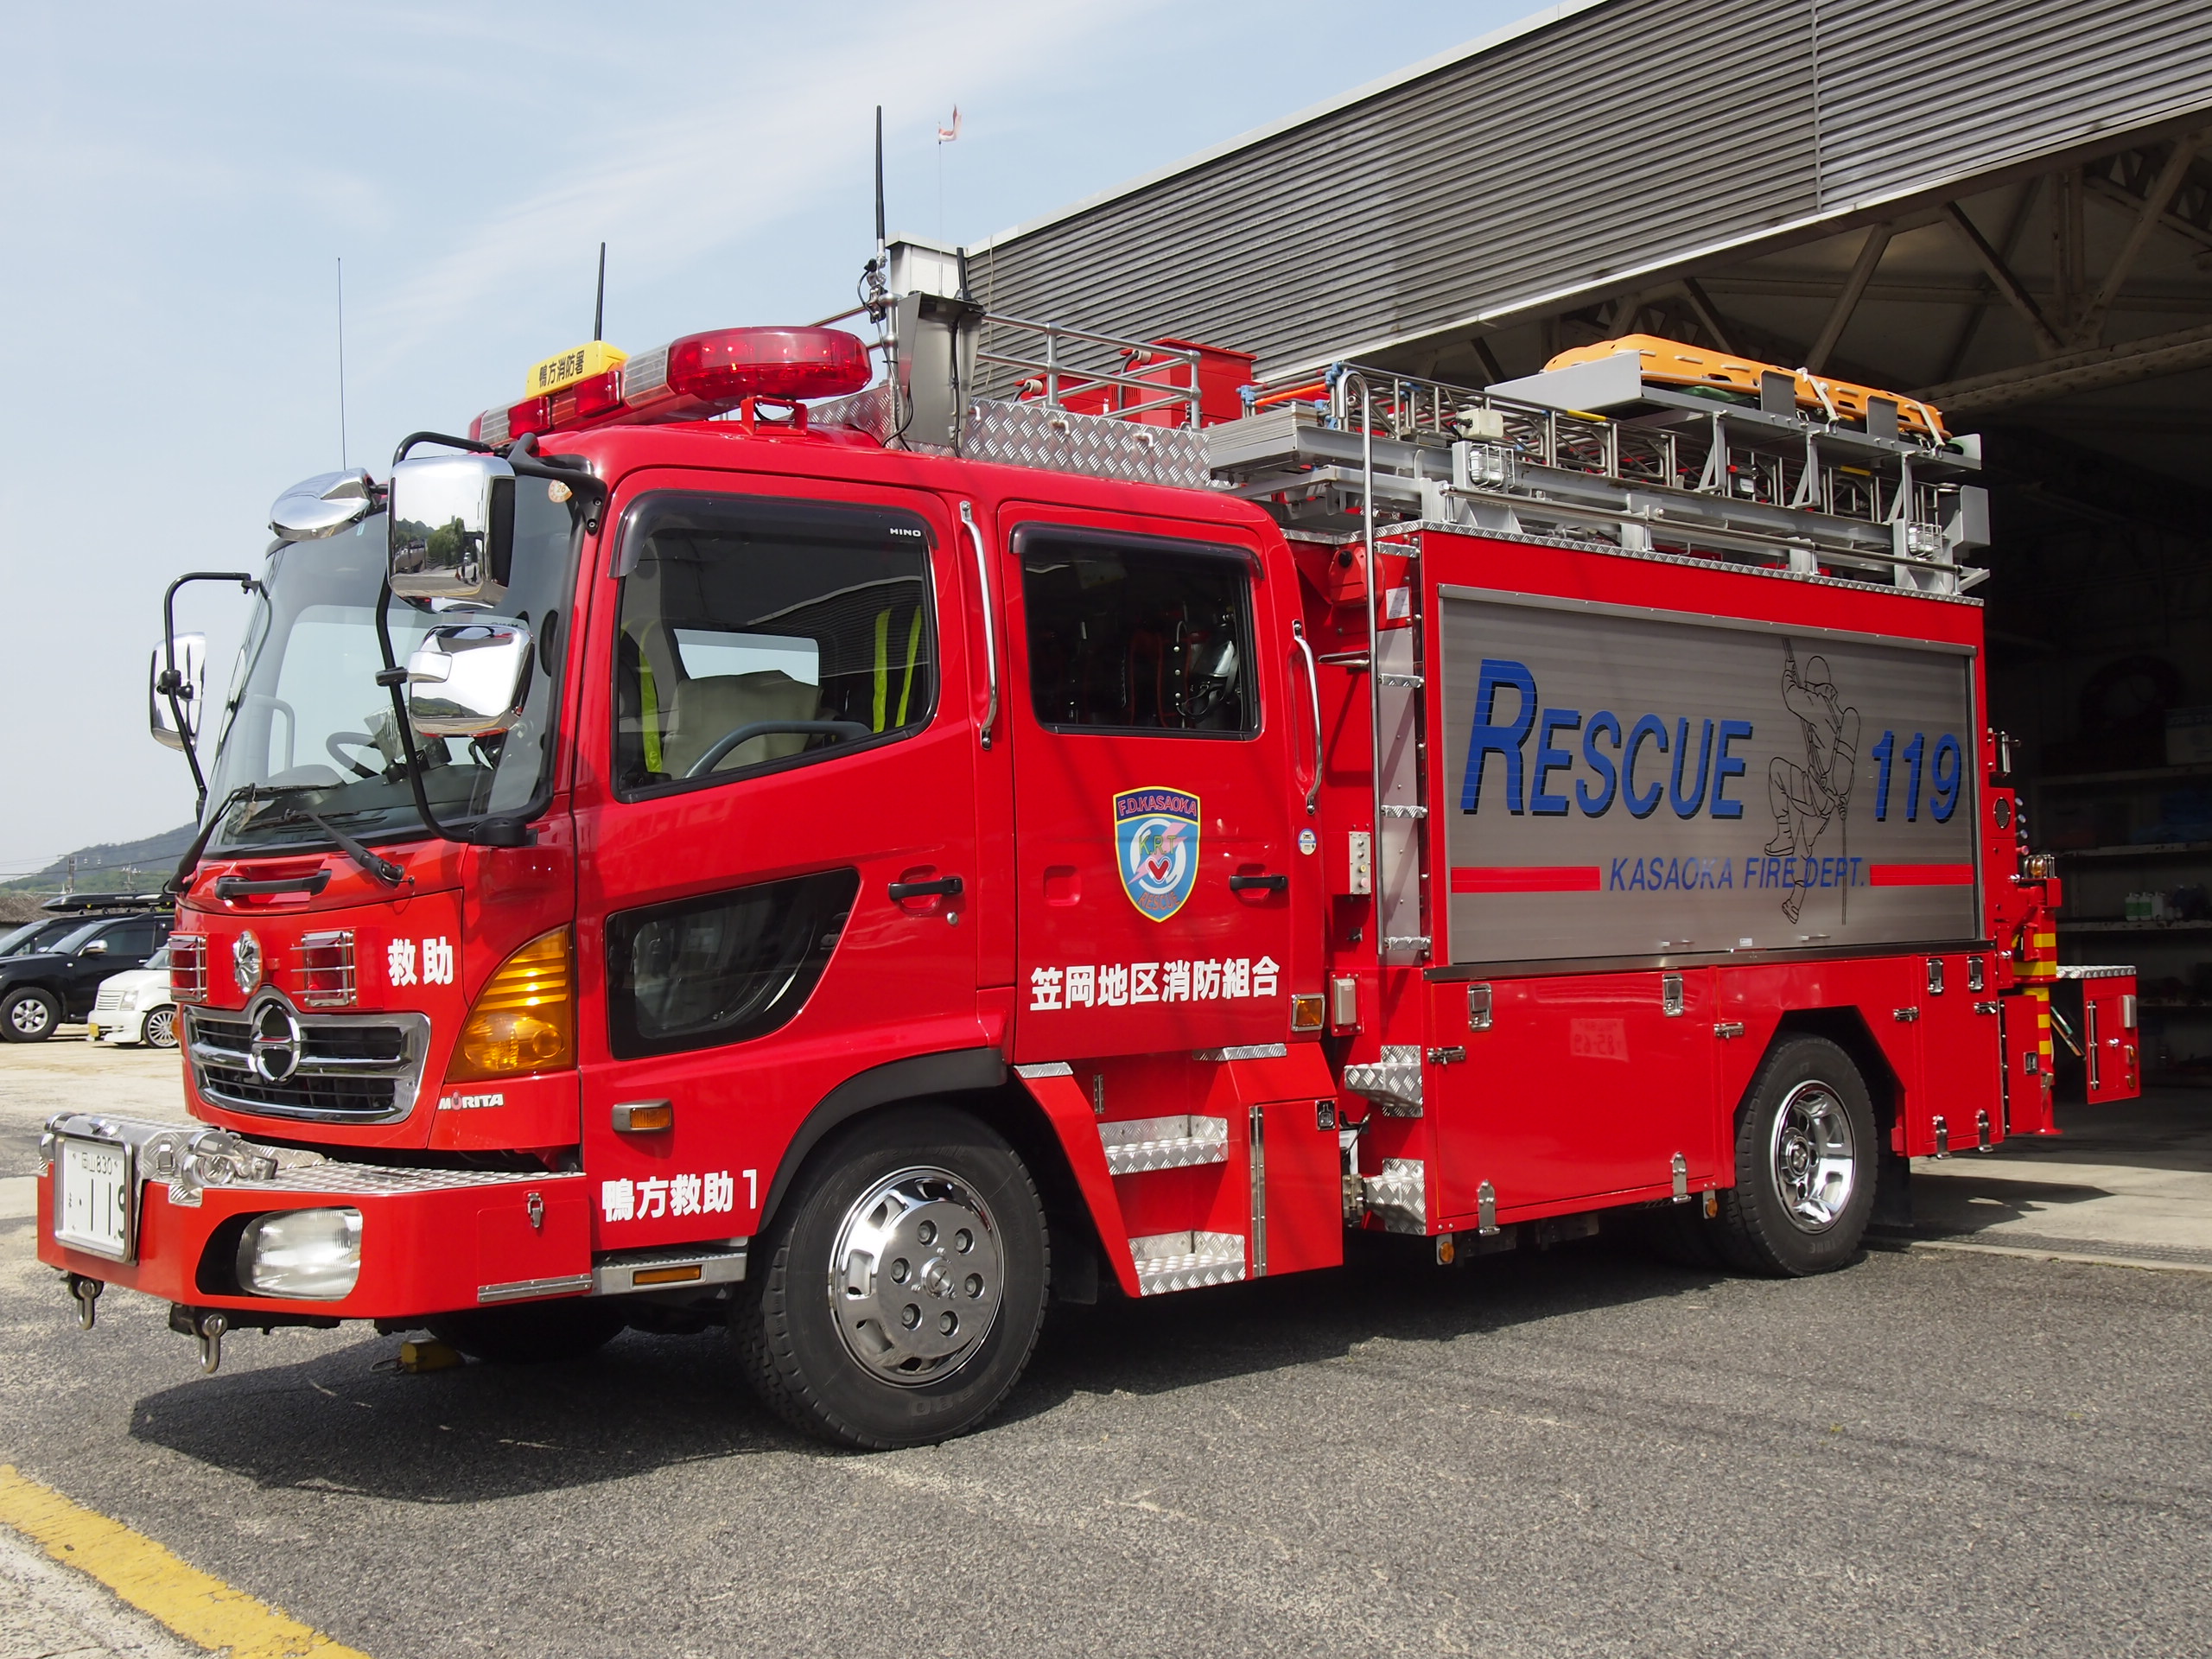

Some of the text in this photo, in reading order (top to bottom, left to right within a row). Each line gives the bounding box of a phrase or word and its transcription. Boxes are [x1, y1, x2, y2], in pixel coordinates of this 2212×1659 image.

[539, 350, 584, 388] 鴨方消防署
[890, 528, 921, 537] HINO
[1872, 730, 1961, 823] 119
[1117, 796, 1197, 817] F.D.KASAOKA
[1609, 857, 1865, 891] KASAOKA FIRE DEPT.
[1137, 891, 1181, 911] RESCUE
[387, 936, 454, 987] 救助
[1030, 956, 1280, 1011] 笠岡地区消防組合
[438, 1090, 504, 1110] MORITA
